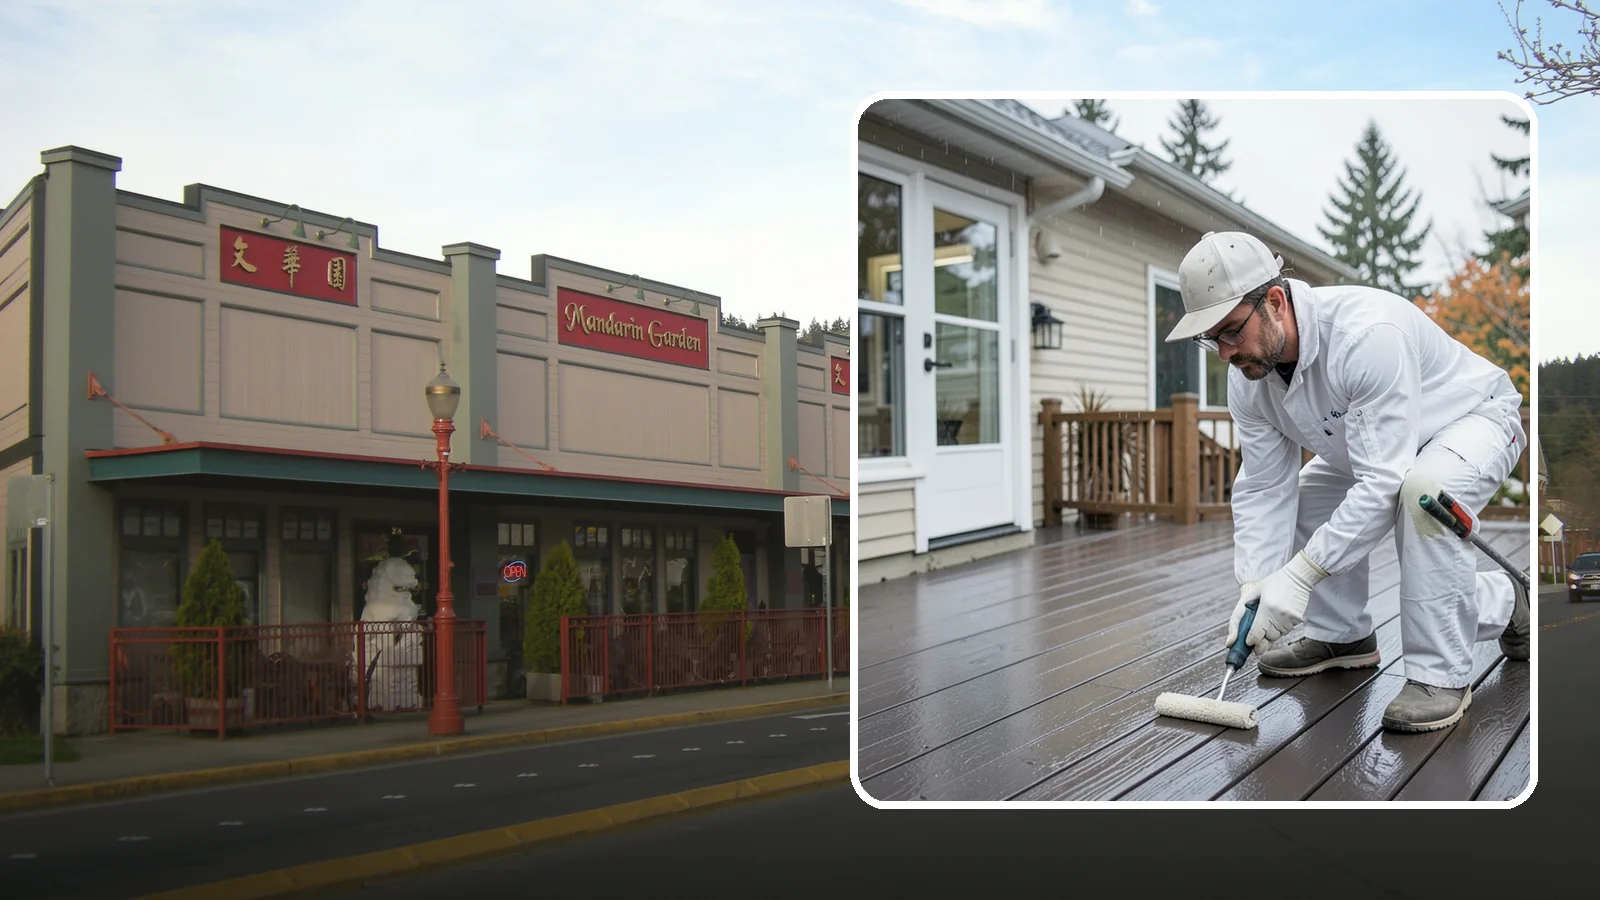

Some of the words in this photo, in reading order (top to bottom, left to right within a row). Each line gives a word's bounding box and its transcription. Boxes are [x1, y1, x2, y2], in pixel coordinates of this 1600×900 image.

[231, 235, 346, 291] 文華園
[564, 302, 644, 341] Mandarin
[648, 320, 701, 351] Garden
[503, 565, 527, 578] OPEN
